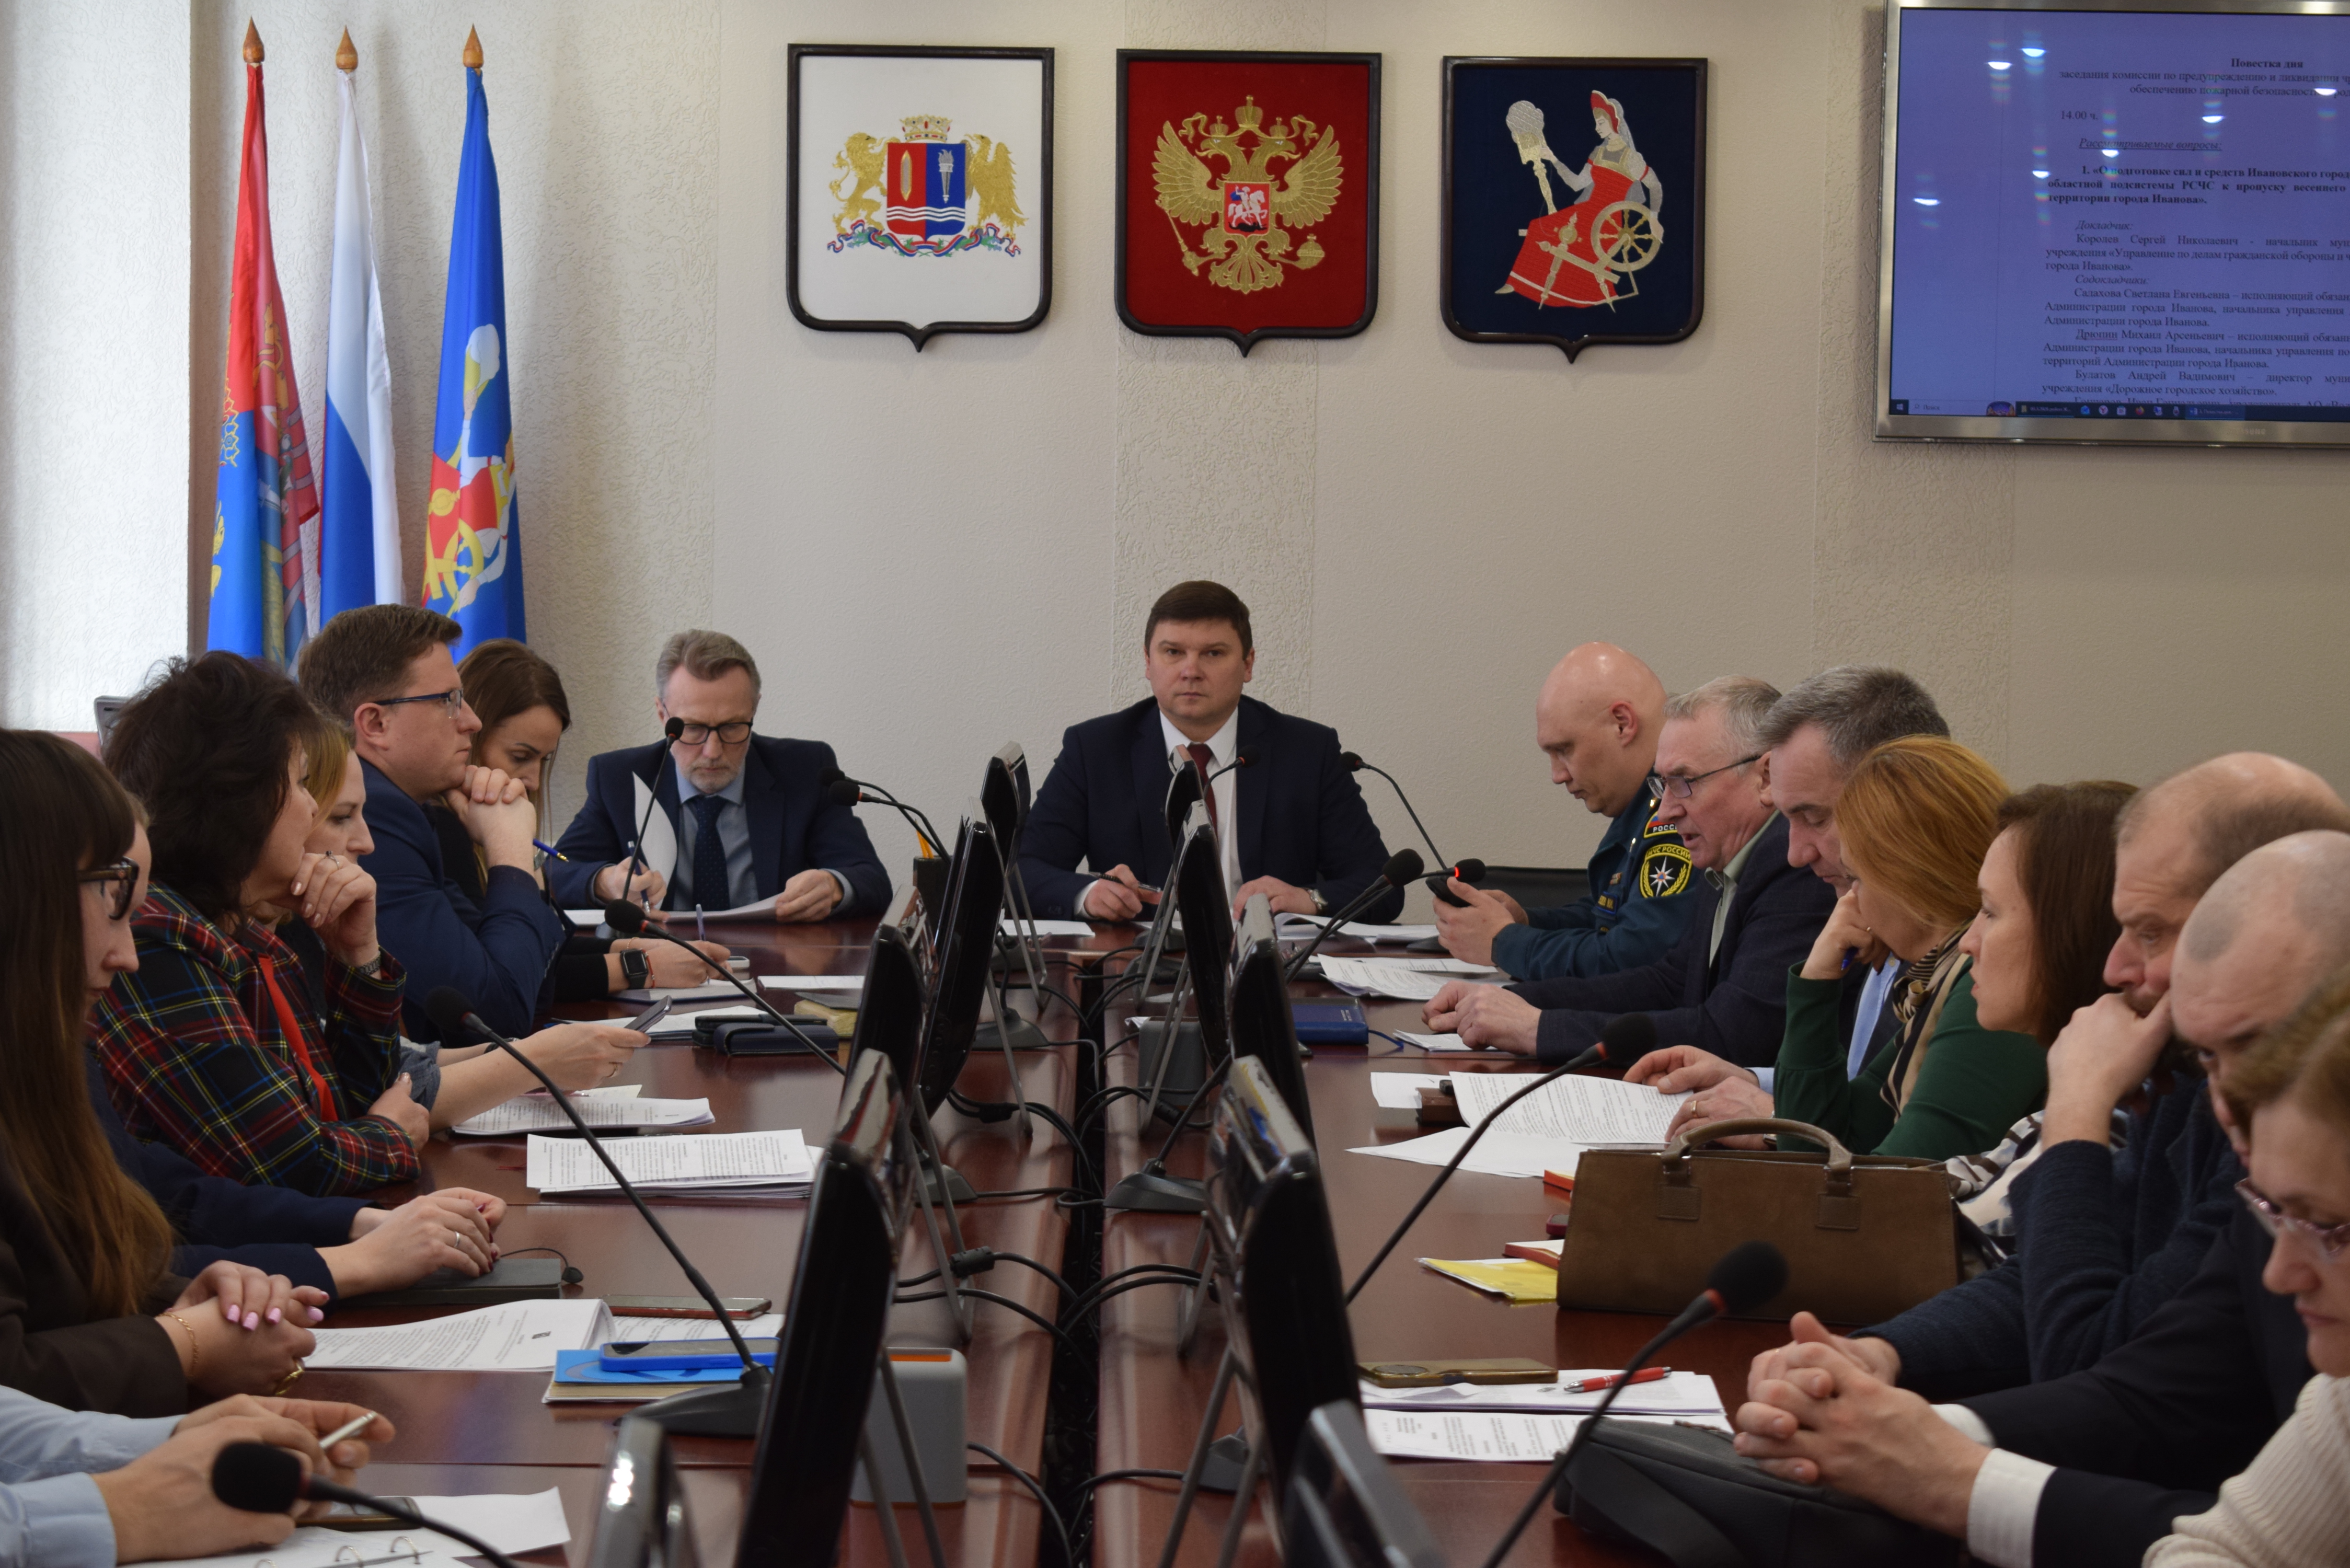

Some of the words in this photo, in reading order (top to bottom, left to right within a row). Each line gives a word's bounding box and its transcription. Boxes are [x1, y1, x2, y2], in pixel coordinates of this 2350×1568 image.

[2231, 59, 2281, 67] Повестка
[2179, 74, 2266, 83] предупреждению
[2129, 84, 2196, 94] обеспечению
[2199, 87, 2249, 97] пожарной
[2253, 86, 2319, 96] безопасност
[2061, 111, 2087, 119] 14.00
[2079, 138, 2174, 151] Рассматриваемые
[2175, 143, 2222, 152] вопросы:
[2082, 166, 2089, 174] 1.
[2093, 166, 2107, 174] «О
[2205, 170, 2244, 178] средств
[2248, 168, 2317, 177] Ивановского
[2048, 179, 2102, 188] областной
[2182, 181, 2214, 190] РСЧС
[2237, 185, 2286, 193] пропуску
[2049, 195, 2110, 204] территории
[2114, 197, 2148, 205] города
[2152, 194, 2206, 203] Иванова».
[2075, 221, 2133, 230] Докладчик:
[2077, 234, 2118, 245] Королев
[2130, 235, 2165, 246] Сергей
[2178, 235, 2238, 245] Николаевич
[2046, 250, 2106, 258] учреждения
[2109, 248, 2175, 260] «Управление
[2224, 251, 2288, 261] гражданской
[2291, 251, 2334, 262] обороны
[2046, 263, 2079, 272] города
[2083, 261, 2133, 270] Иванова».
[2075, 275, 2149, 284] Содокладчики:
[2074, 288, 2121, 297] Салахова
[2124, 290, 2170, 298] Светлана
[2173, 290, 2230, 299] Евгеньевна
[2241, 292, 2313, 301] исполняющий
[2045, 303, 2125, 313] Администрации
[2132, 305, 2165, 314] города
[2172, 303, 2216, 313] Иванова,
[2286, 308, 2344, 317] управления
[2044, 317, 2125, 327] Администрации
[2128, 319, 2162, 328] города
[2165, 317, 2209, 326] Иванова.
[2122, 330, 2161, 339] Михаил
[2165, 331, 2224, 341] Арсеньевич
[2238, 333, 2309, 342] исполняющий
[2043, 343, 2124, 354] Администрации
[2128, 346, 2162, 355] города
[2276, 349, 2334, 358] управления
[2043, 358, 2100, 367] территорий
[2104, 358, 2185, 368] Администрации
[2188, 361, 2221, 369] города
[2225, 359, 2268, 368] Иванова.
[2076, 370, 2116, 381] Булатов
[2128, 371, 2166, 382] Андрей
[2179, 371, 2234, 381] Вадимович
[2266, 375, 2312, 385] директор
[2042, 386, 2102, 394] учреждения
[2105, 384, 2162, 395] «Дорожное
[2165, 387, 2215, 396] городское
[2219, 386, 2276, 395] хозяйство».
[1653, 824, 1677, 833] РОСС
[1648, 847, 1661, 856] МЧС
[1662, 847, 1690, 859] РОССИИ
